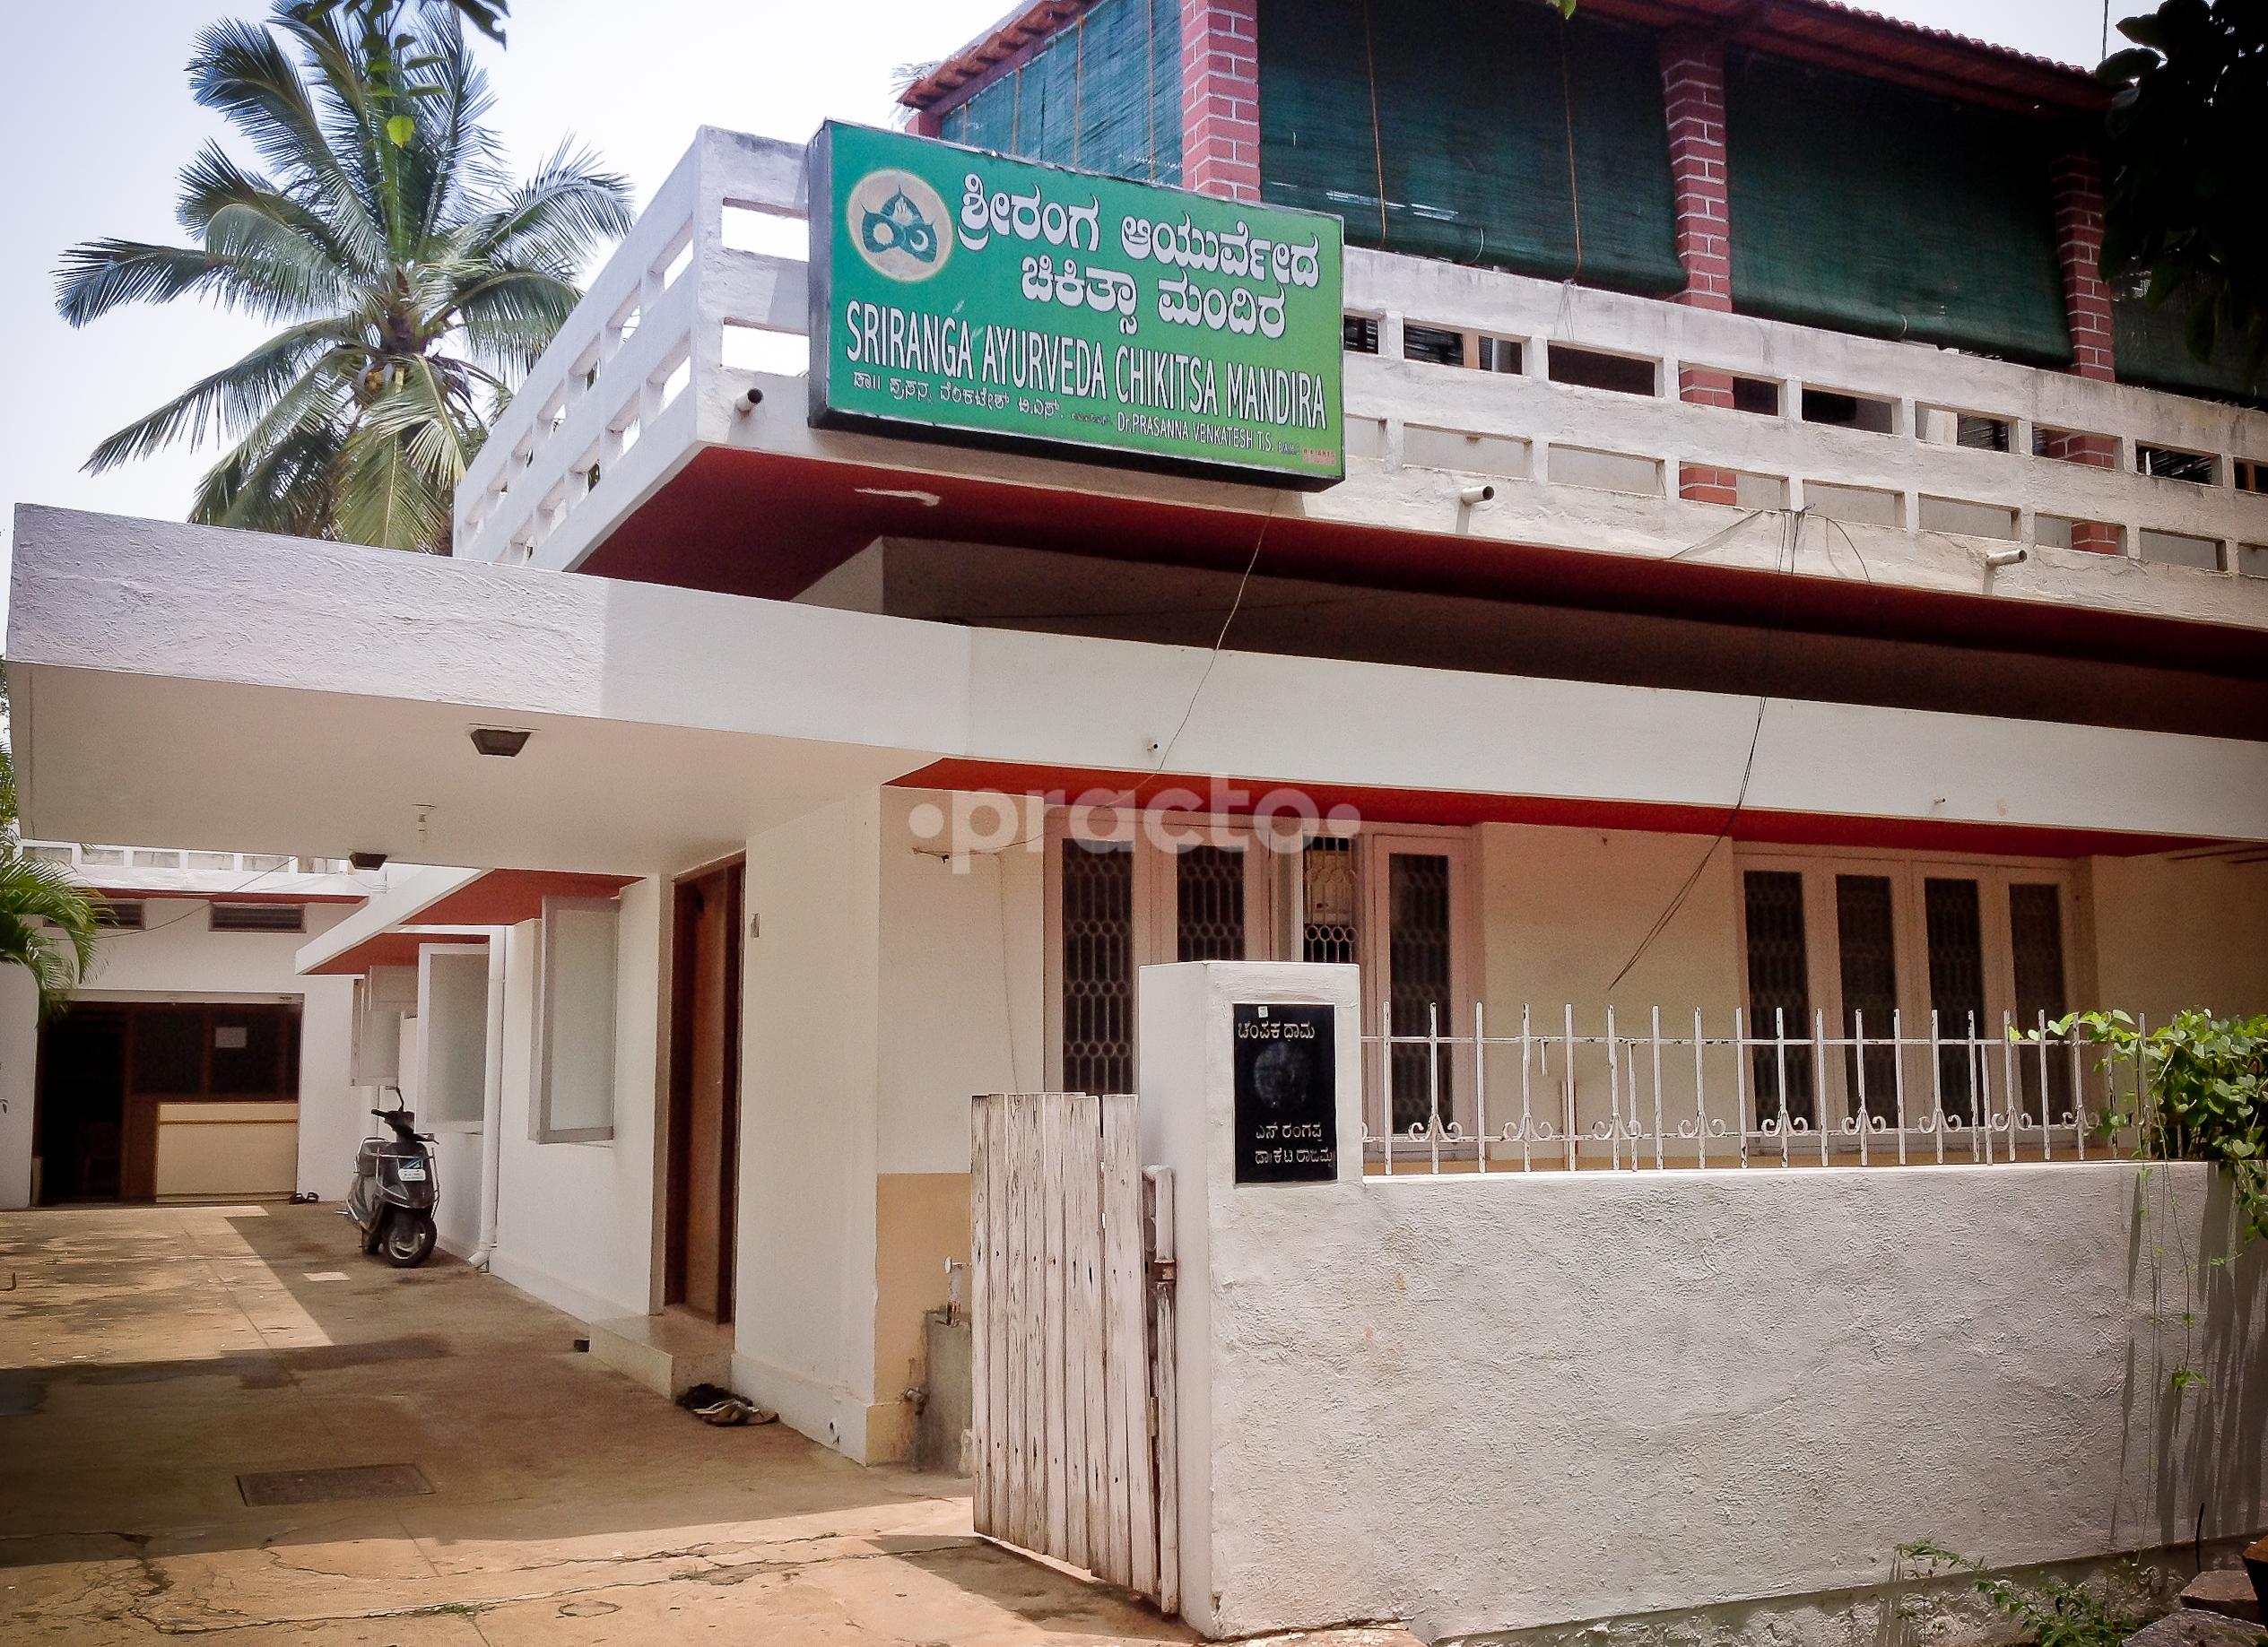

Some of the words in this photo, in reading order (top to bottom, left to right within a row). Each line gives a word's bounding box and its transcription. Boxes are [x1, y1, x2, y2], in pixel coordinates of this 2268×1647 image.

[957, 173, 1100, 252] ಶ್ರೀರಂಗ
[1121, 211, 1320, 289] ಆಯುರ್ವೇದ
[1021, 254, 1138, 335] ಚಿಕಿತ್ಸಾ
[1157, 269, 1286, 340] ಮಂದಿರ
[846, 300, 974, 381] SRIRANGA
[981, 325, 1108, 400] AYURVEDA
[1115, 345, 1219, 416] CHIKITSA
[1226, 361, 1327, 430] MANDIRA
[1193, 421, 1253, 450] VENKATESH
